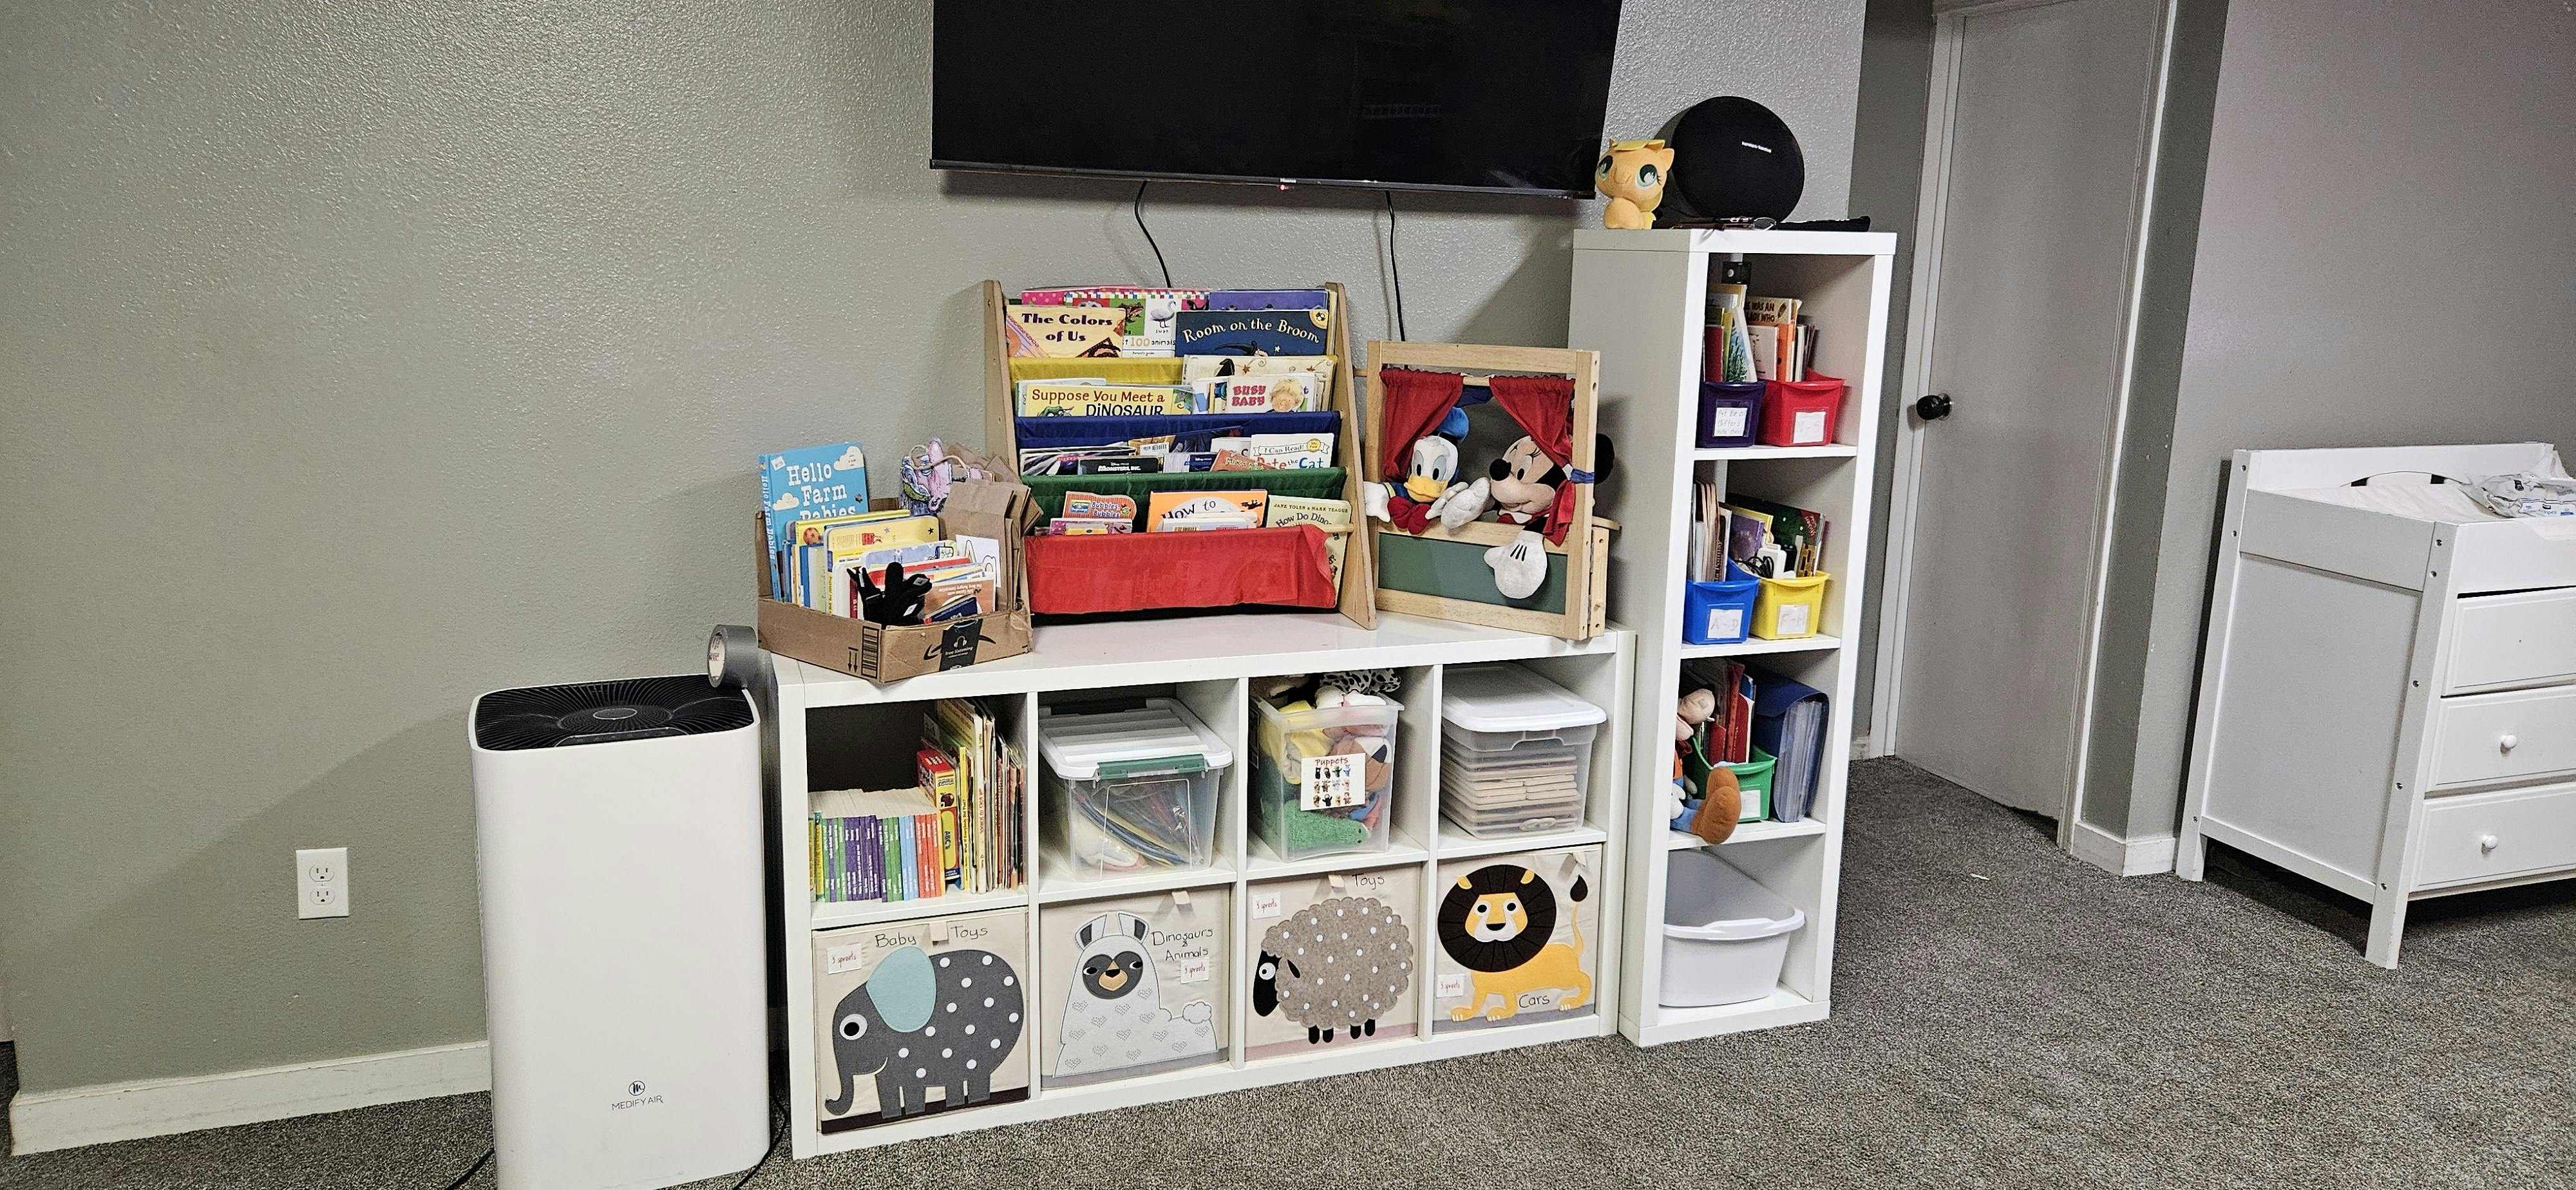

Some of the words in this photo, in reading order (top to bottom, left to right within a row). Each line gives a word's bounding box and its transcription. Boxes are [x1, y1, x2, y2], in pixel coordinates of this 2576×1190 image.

[1021, 313, 1054, 324] The
[1059, 314, 1113, 325] Colors
[1046, 331, 1064, 342] of
[1068, 332, 1086, 341] Us
[1182, 323, 1226, 344] Room
[1230, 321, 1247, 331] on
[1251, 318, 1272, 330] the
[1277, 319, 1320, 343] Broom
[1130, 337, 1150, 346] 100
[1032, 389, 1090, 404] Suppose
[1094, 390, 1117, 402] You
[1121, 391, 1153, 402] Meet
[1233, 386, 1267, 395] BUSY
[1232, 396, 1265, 406] BABY
[1299, 457, 1324, 469] Cat
[786, 463, 831, 486] Hello
[801, 484, 848, 507] Farm
[1203, 500, 1216, 511] to
[1276, 516, 1294, 527] How
[1314, 757, 1349, 766] Puppets
[1352, 873, 1385, 890] Toys
[1261, 898, 1277, 914] sprouts
[875, 932, 917, 948] Baby
[950, 925, 989, 940] Toys
[1151, 929, 1213, 946] Dinosaurs
[837, 952, 857, 968] sprouts
[1166, 947, 1209, 961] Animals
[1189, 962, 1206, 978] sprouts
[1444, 979, 1461, 994] sprouts
[1519, 994, 1550, 1008] Cars
[612, 1097, 647, 1111] MEDIFY
